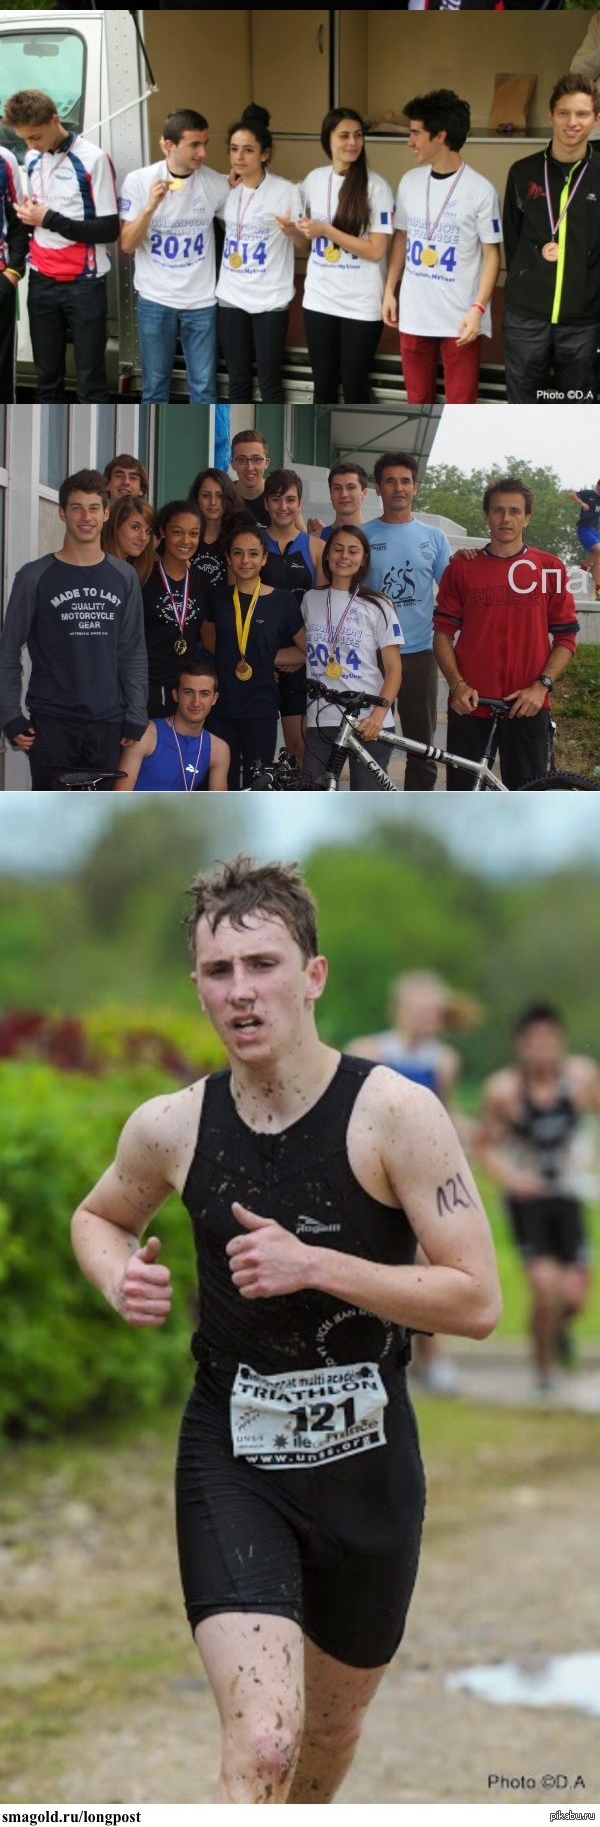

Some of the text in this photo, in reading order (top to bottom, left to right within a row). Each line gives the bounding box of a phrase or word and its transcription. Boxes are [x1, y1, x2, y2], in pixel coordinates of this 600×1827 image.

[150, 232, 204, 260] 2014
[50, 587, 121, 608] MADE TO LAST
[71, 602, 105, 611] QUALITY
[61, 612, 115, 621] MOTORCYCLE
[78, 621, 101, 629] GEAR
[307, 643, 362, 670] 2014
[437, 1173, 480, 1217] 121
[333, 1308, 357, 1325] JEAN
[299, 1373, 325, 1387] multi
[238, 1380, 379, 1404] TRIATHLON
[287, 1397, 357, 1432] 121
[246, 1436, 372, 1464] www.unss.org
